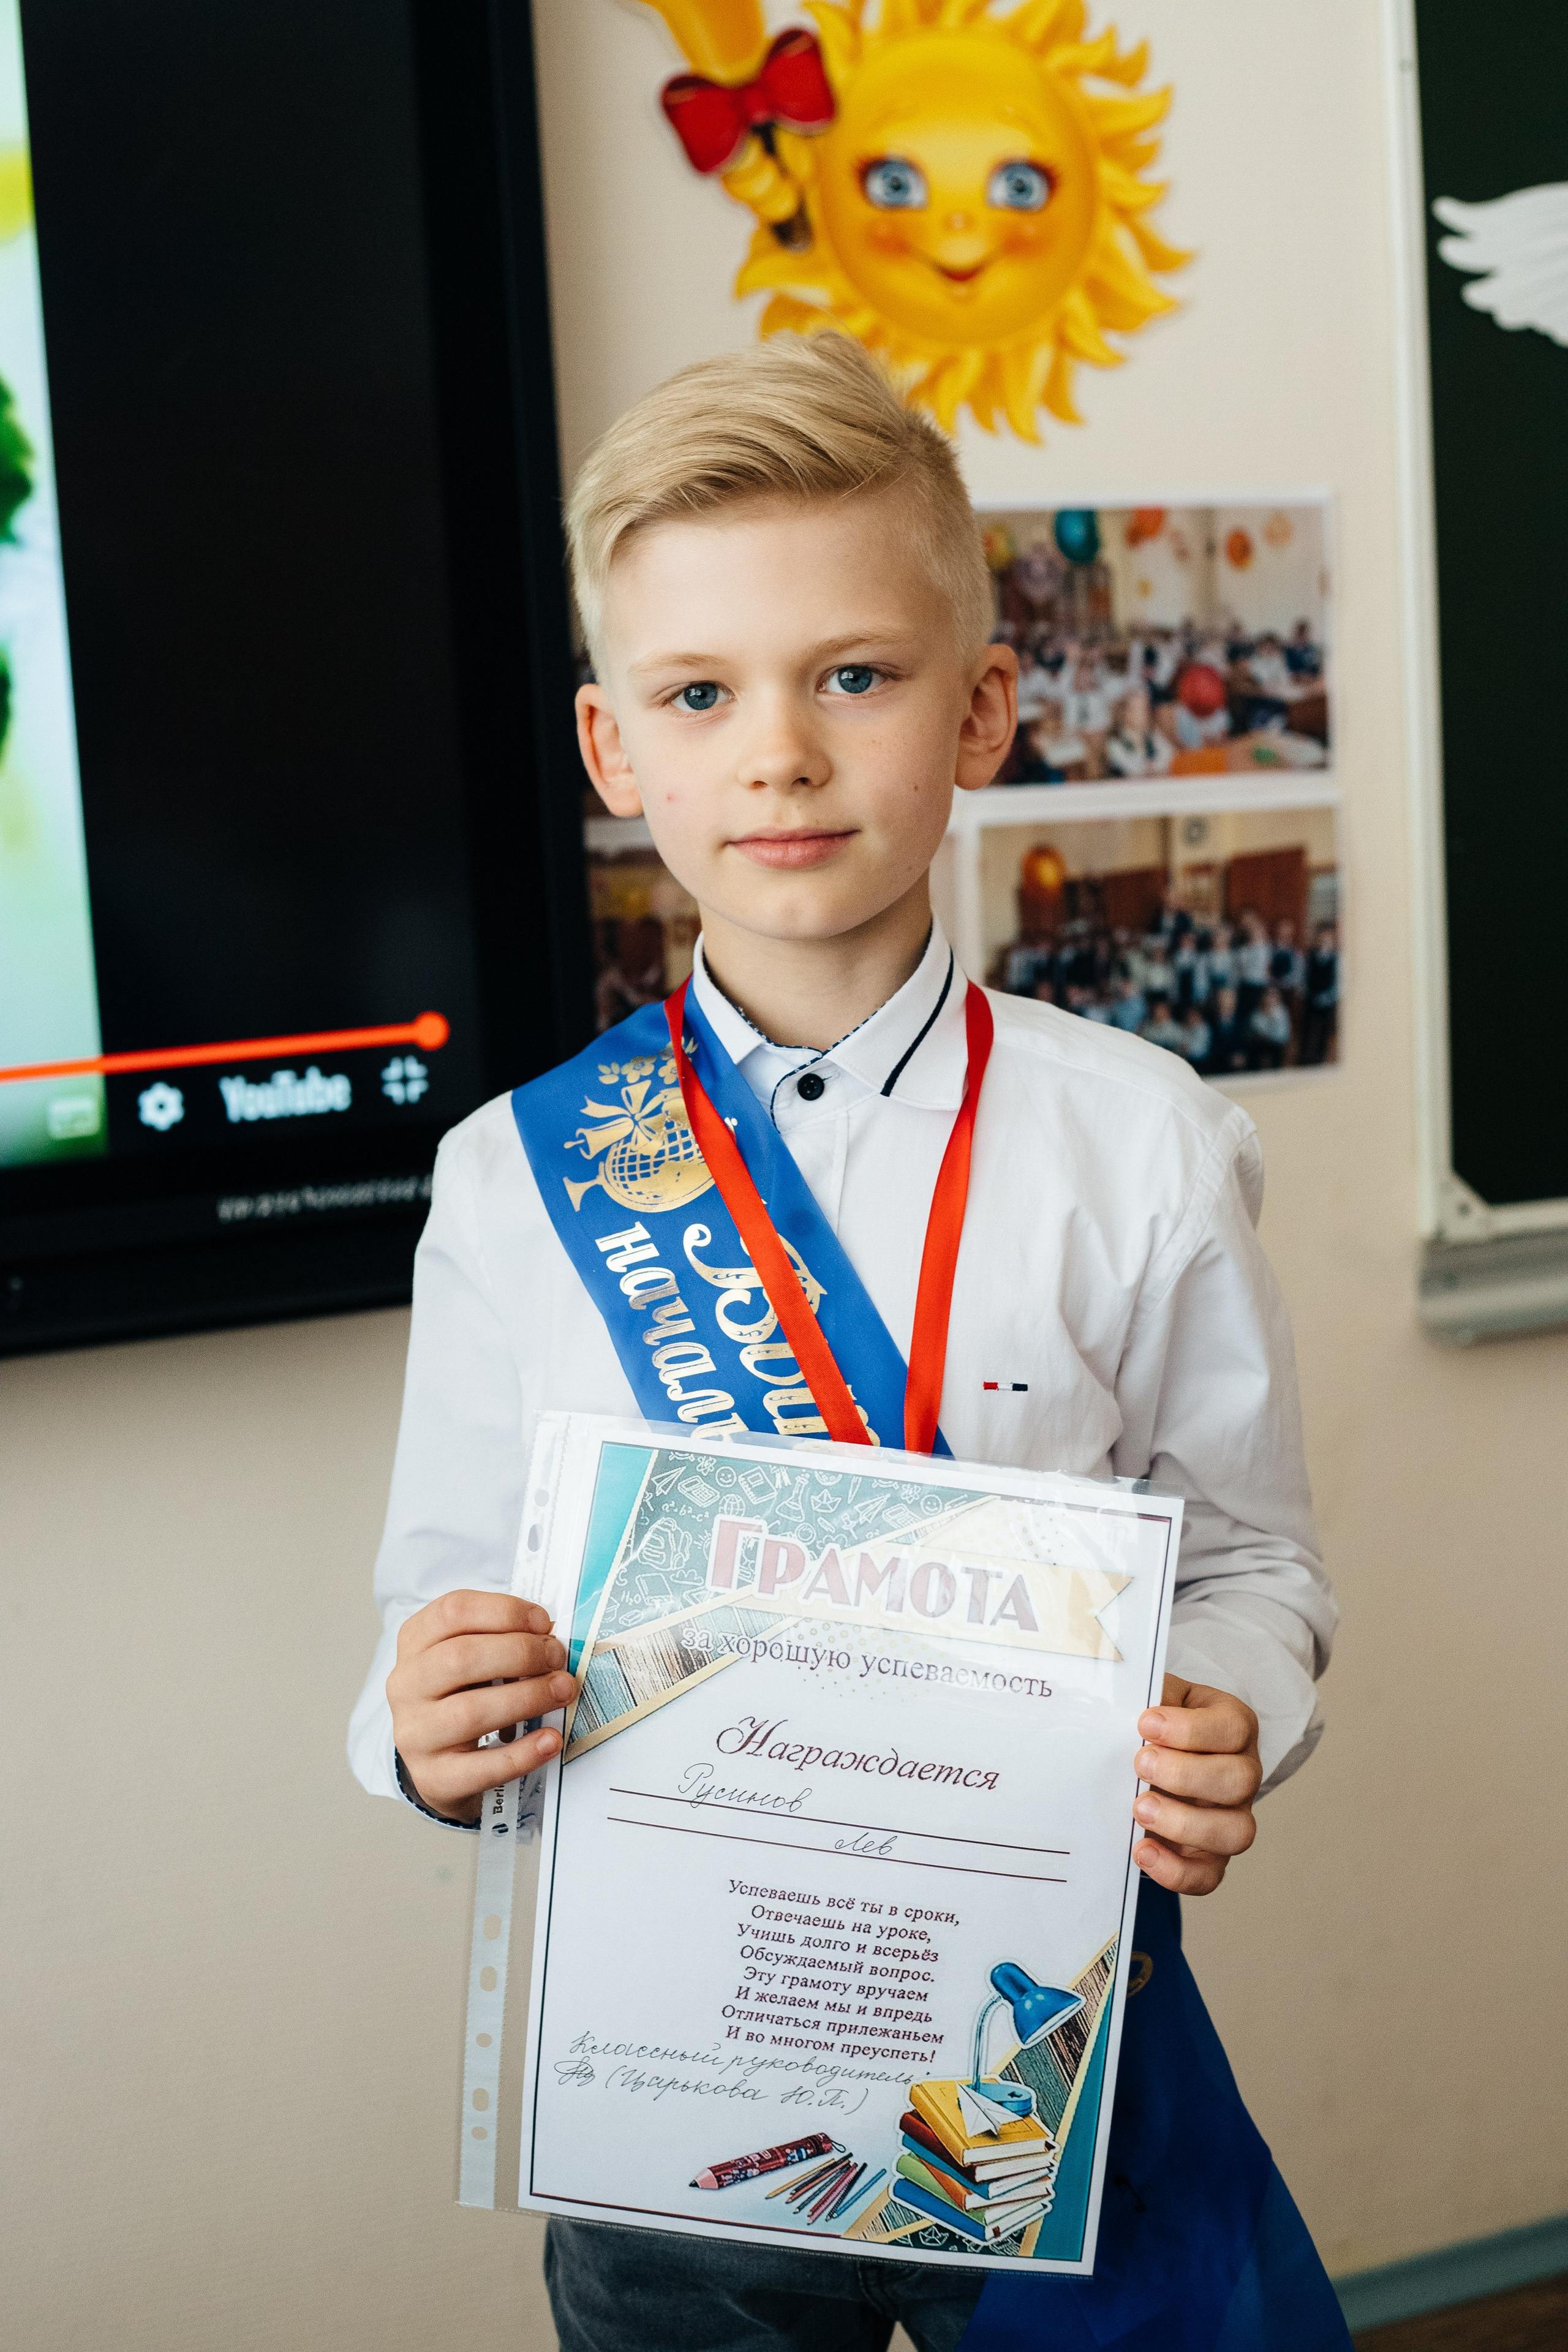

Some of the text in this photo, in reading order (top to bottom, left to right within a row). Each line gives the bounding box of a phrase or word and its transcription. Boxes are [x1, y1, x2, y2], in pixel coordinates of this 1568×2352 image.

[219, 1066, 352, 1123] YouTube
[710, 1518, 1040, 1634] ГРАМОТА
[681, 1627, 1054, 1698] за хорошую успеваемость
[716, 1716, 1000, 1790] Награждается
[678, 1763, 812, 1812] Русинов
[834, 1832, 897, 1855] Лев
[729, 1879, 960, 1926] Успеваешь всё ты в сроки,
[737, 1923, 939, 1962] Учишь долго и всерьёз
[751, 1904, 932, 1943] Отвечаешь на уроке,
[740, 1945, 935, 1983] Обсуждаемый вопрос.
[743, 1966, 929, 2002] Эту грамоту вручаем
[722, 2005, 944, 2044] Отличаться прилежаньем
[735, 1986, 932, 2024] И желаем мы и впредь
[570, 2031, 724, 2065] Классный
[725, 2026, 936, 2063] И во многом преуспеть!
